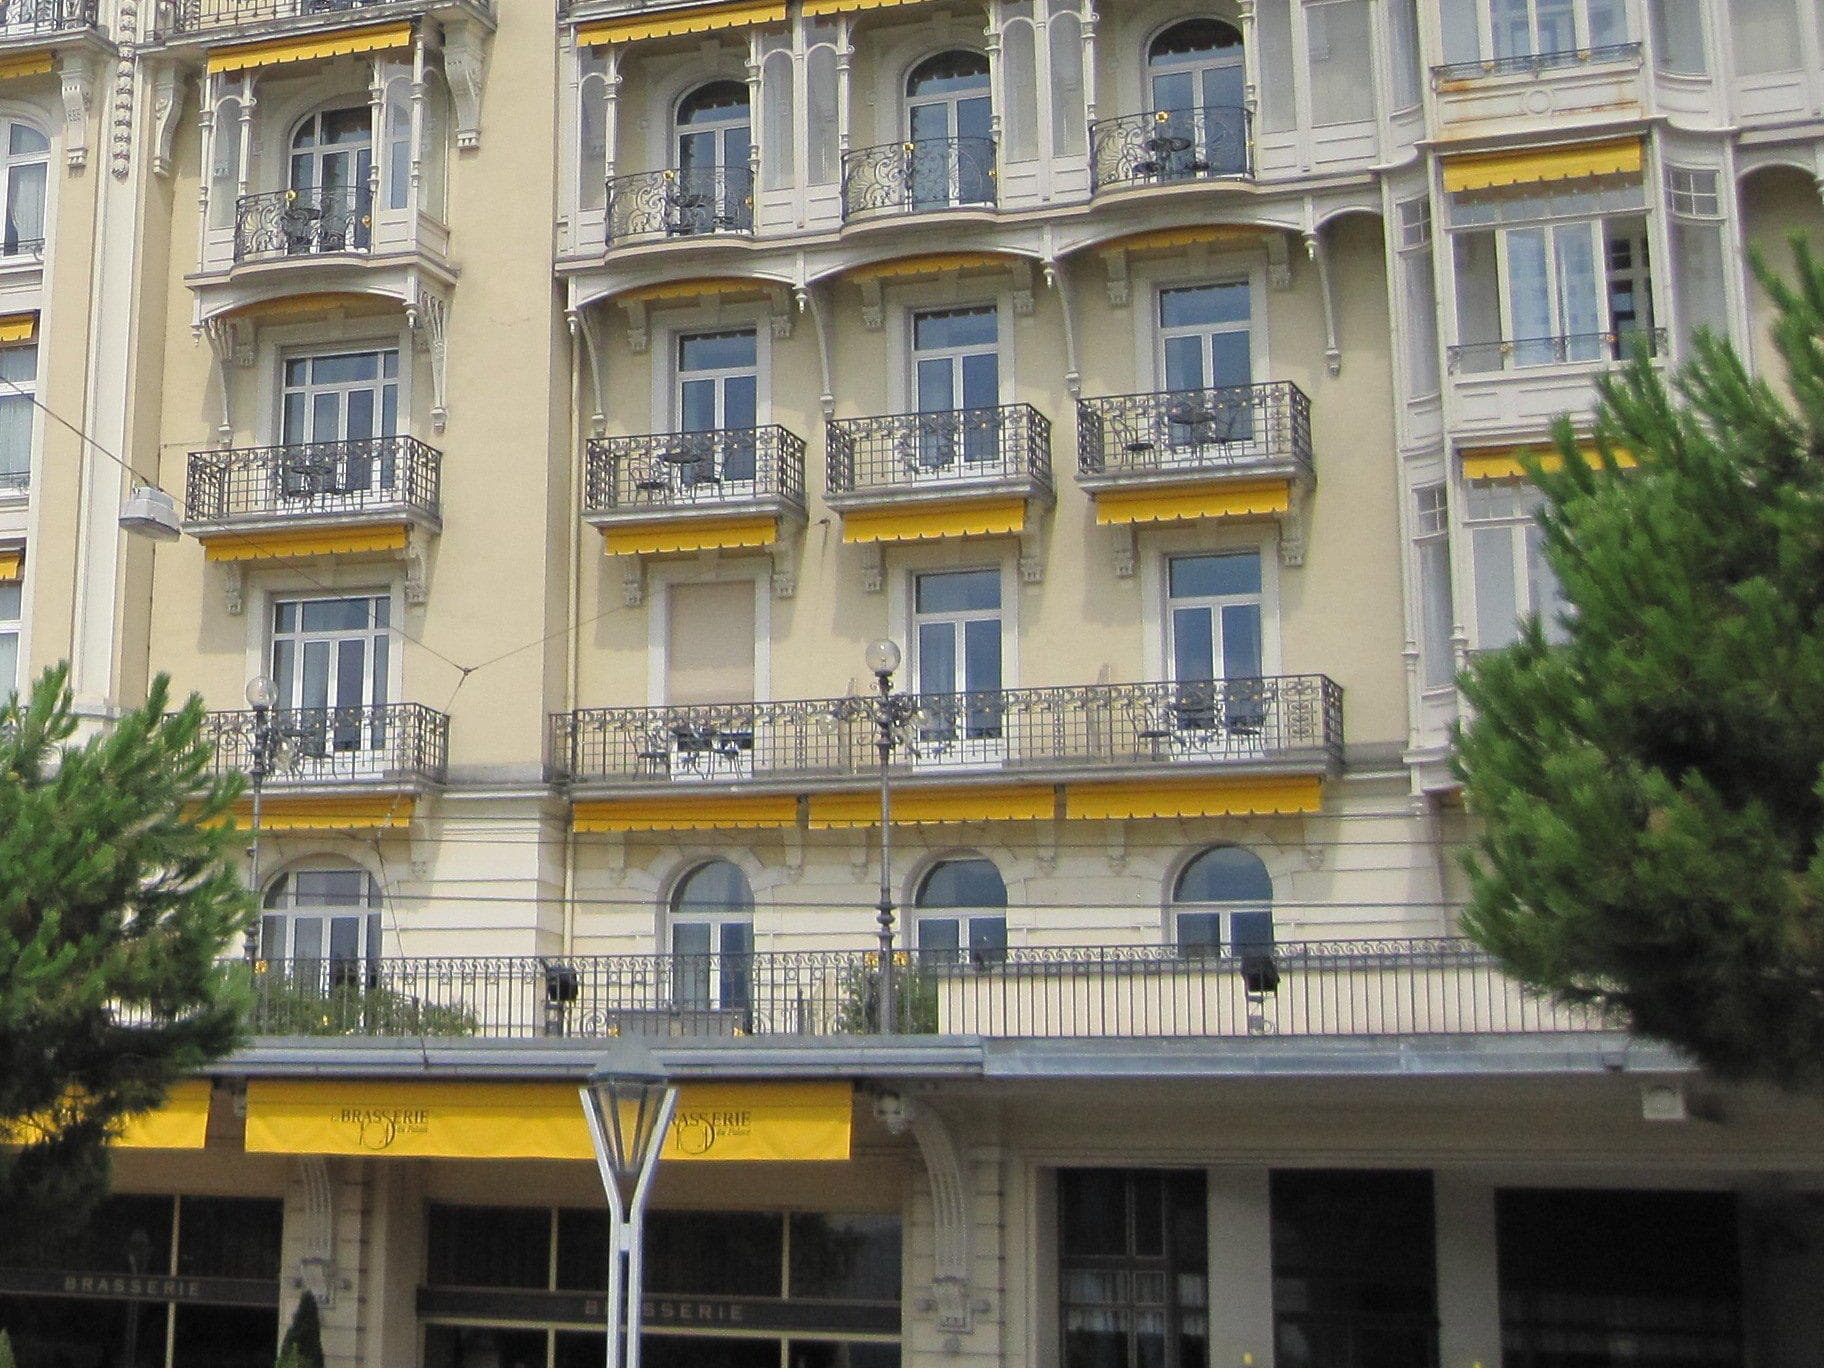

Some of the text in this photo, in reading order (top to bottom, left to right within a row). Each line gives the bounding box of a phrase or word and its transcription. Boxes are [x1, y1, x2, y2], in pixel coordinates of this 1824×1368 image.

[341, 1109, 428, 1124] BRASSERIE
[670, 1111, 751, 1126] RASSERIE
[64, 1275, 201, 1297] BRASSERIE
[584, 1299, 743, 1321] BSSERIE
